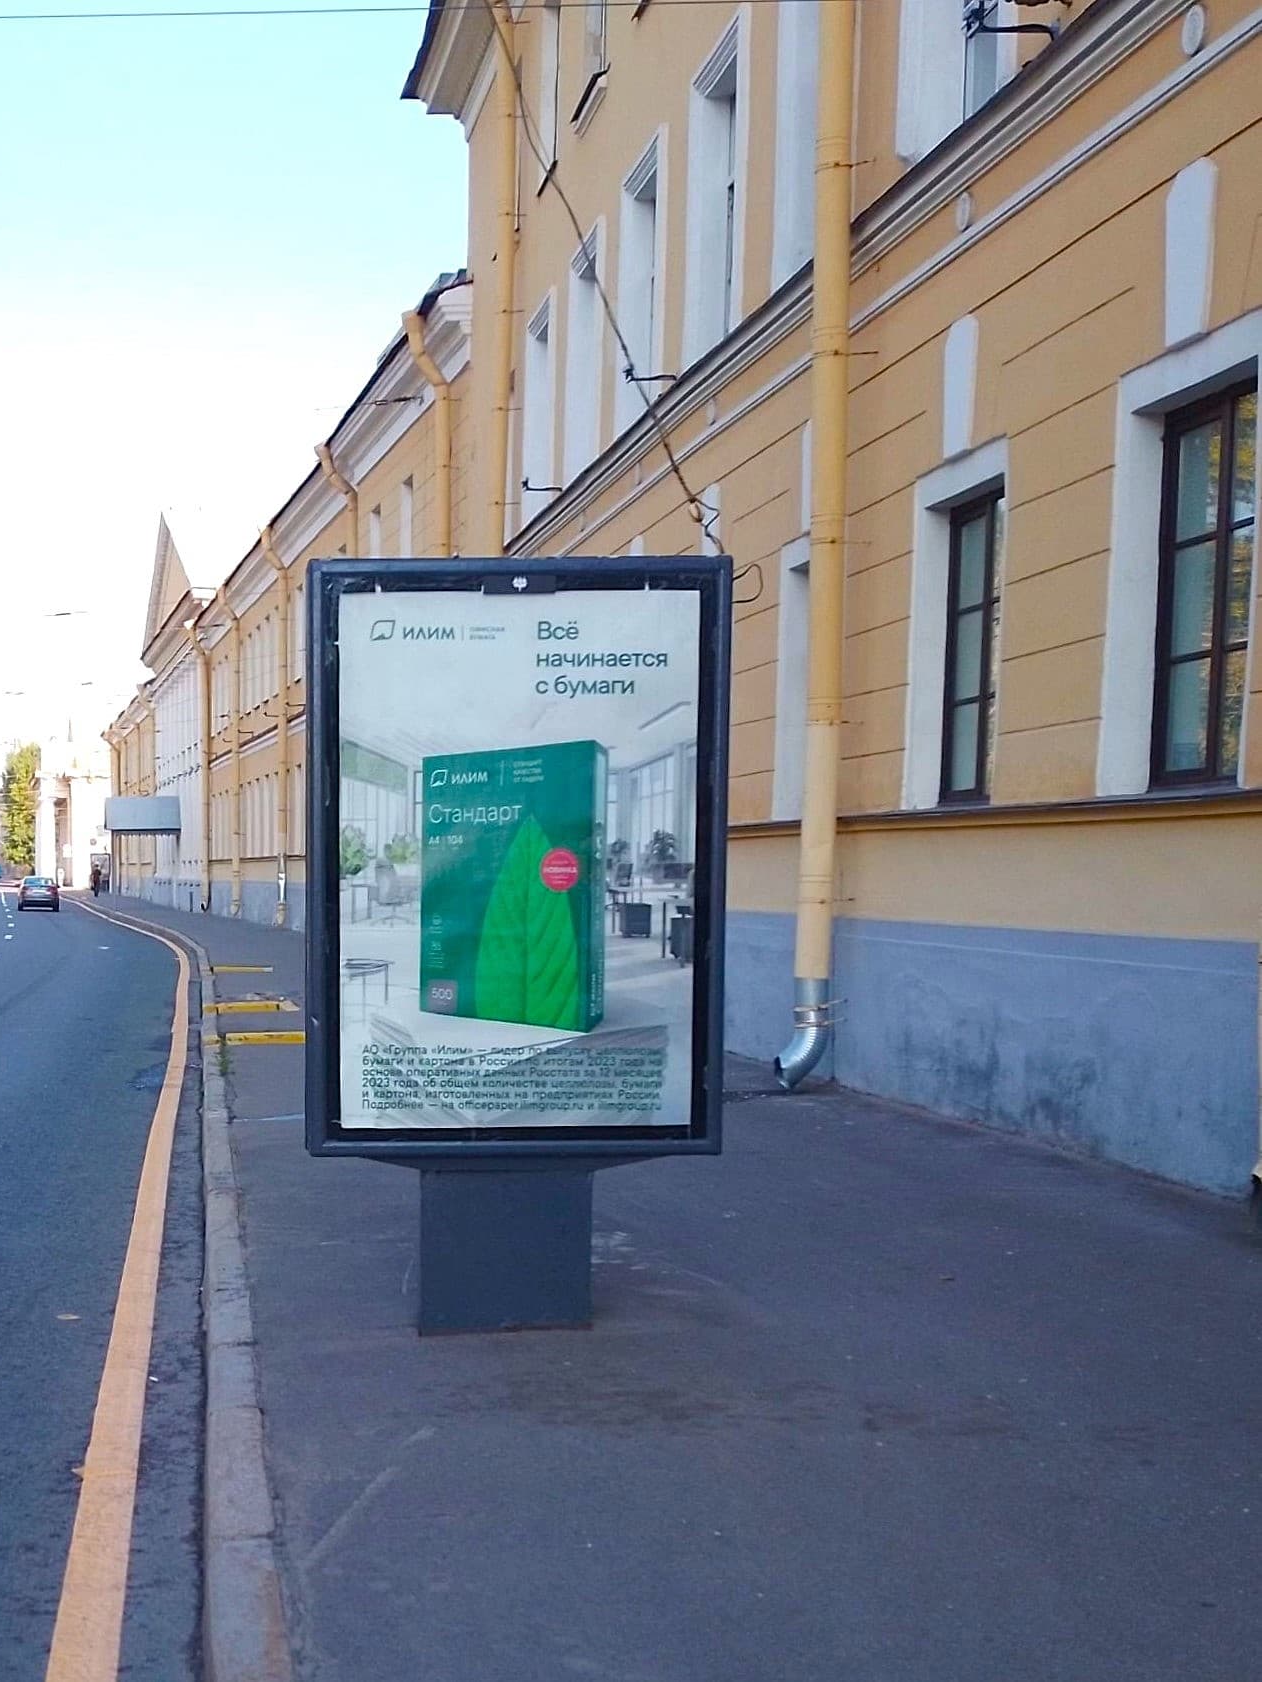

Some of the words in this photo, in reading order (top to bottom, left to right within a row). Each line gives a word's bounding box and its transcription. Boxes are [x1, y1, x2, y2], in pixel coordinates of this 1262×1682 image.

[537, 620, 579, 640] Всё
[536, 651, 668, 667] начинается
[536, 679, 547, 694] с
[554, 674, 634, 698] бумаги
[429, 804, 522, 826] Стандарт
[431, 987, 454, 1001] 500
[362, 1045, 379, 1054] АО
[383, 1044, 427, 1055] «Группа
[431, 1045, 473, 1054] «Илим»
[362, 1055, 403, 1067] бумаги
[588, 1056, 616, 1065] 2023
[362, 1078, 390, 1087] 2023
[394, 1080, 419, 1088] года
[423, 1079, 436, 1087] об
[440, 1079, 478, 1088] общем
[362, 1100, 423, 1110] Подробнее
